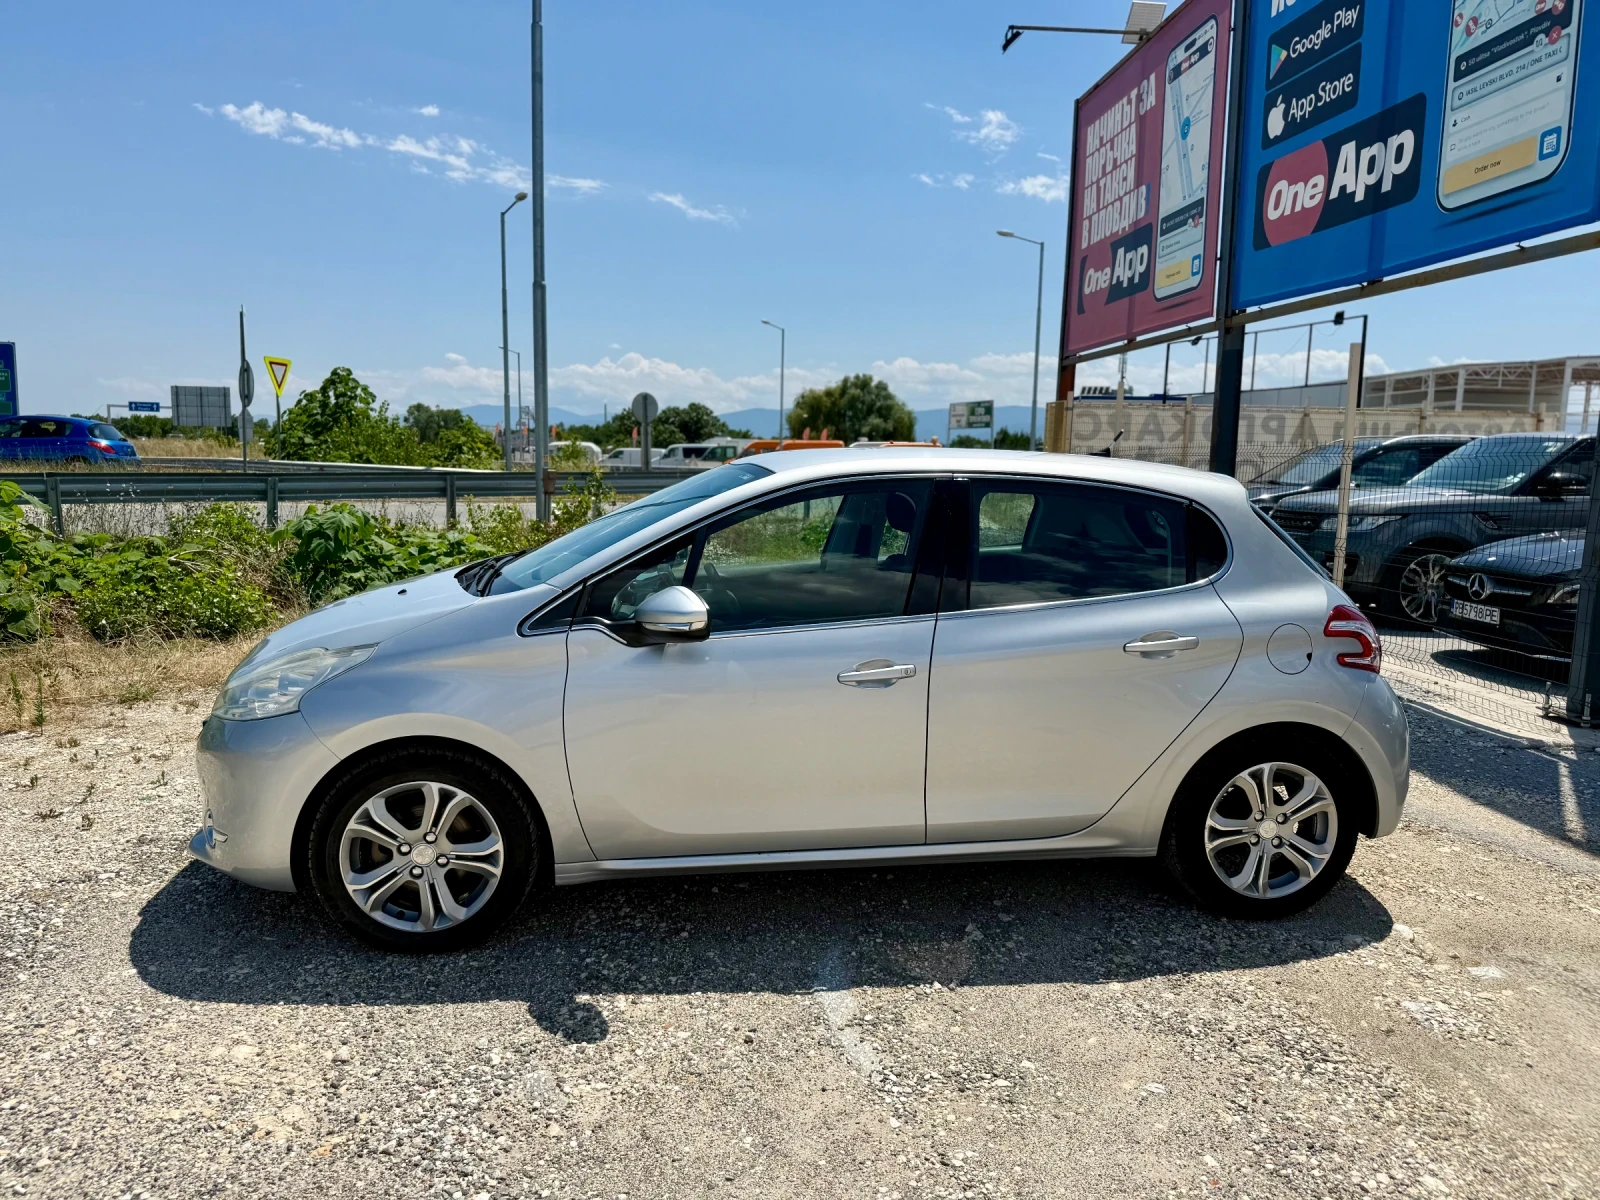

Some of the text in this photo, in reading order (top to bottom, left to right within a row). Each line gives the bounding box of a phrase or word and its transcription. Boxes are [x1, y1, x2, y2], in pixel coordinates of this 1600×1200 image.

[1289, 20, 1332, 58] Google
[1333, 5, 1360, 33] Play
[1530, 20, 1551, 36] Plovdiv
[1479, 77, 1499, 91] LEVSKI
[1498, 69, 1514, 82] BLVD.
[1515, 64, 1526, 75] 214
[1530, 57, 1543, 67] ONE
[1544, 49, 1558, 60] TAXI
[1085, 72, 1156, 157] НАЧИНЪТ ЗА
[1288, 73, 1354, 123] App Store
[1084, 122, 1136, 187] ПОРЪЧКА
[1267, 129, 1415, 221] One App
[1474, 160, 1502, 174] Order now
[1083, 157, 1136, 219] НА ТАКСИ
[1081, 218, 1090, 250] В
[1084, 244, 1148, 295] One App
